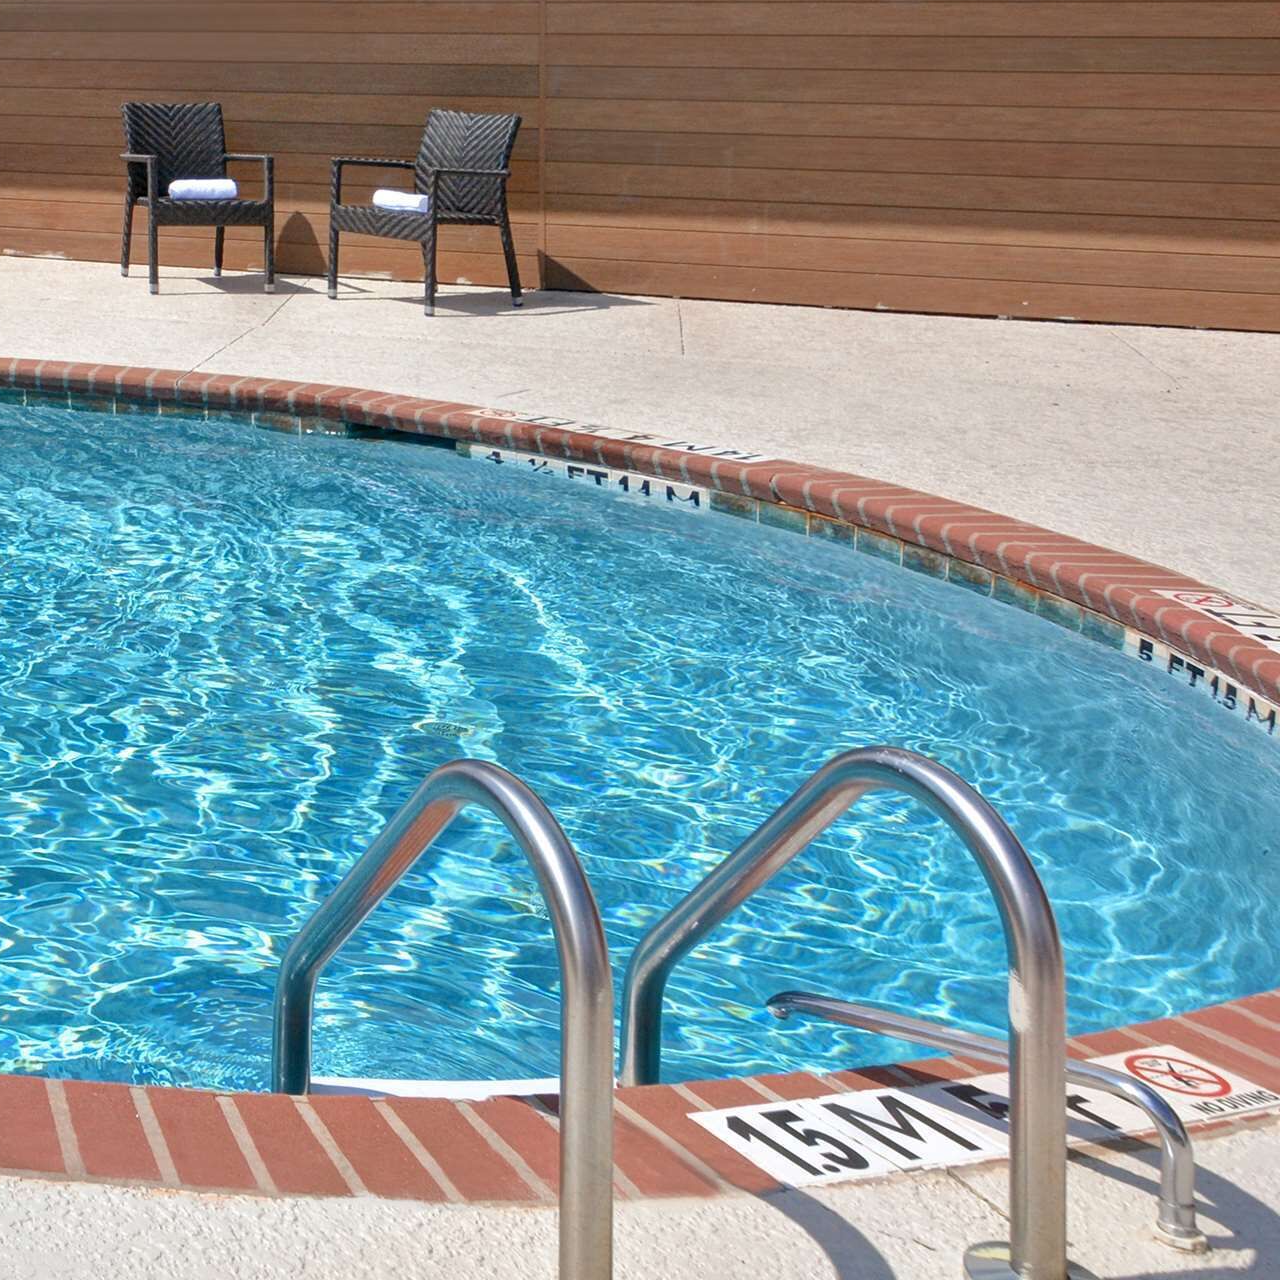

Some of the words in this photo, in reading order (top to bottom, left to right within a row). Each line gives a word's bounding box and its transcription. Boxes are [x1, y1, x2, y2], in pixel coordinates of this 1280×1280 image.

[567, 465, 608, 486] FT
[666, 485, 700, 507] M
[1138, 638, 1153, 662] 5
[1168, 653, 1204, 687] FT
[1246, 697, 1276, 735] M
[1190, 1101, 1226, 1115] NO
[1215, 1090, 1280, 1109] DIVING
[726, 1109, 870, 1176] 1.5
[820, 1095, 983, 1160] M
